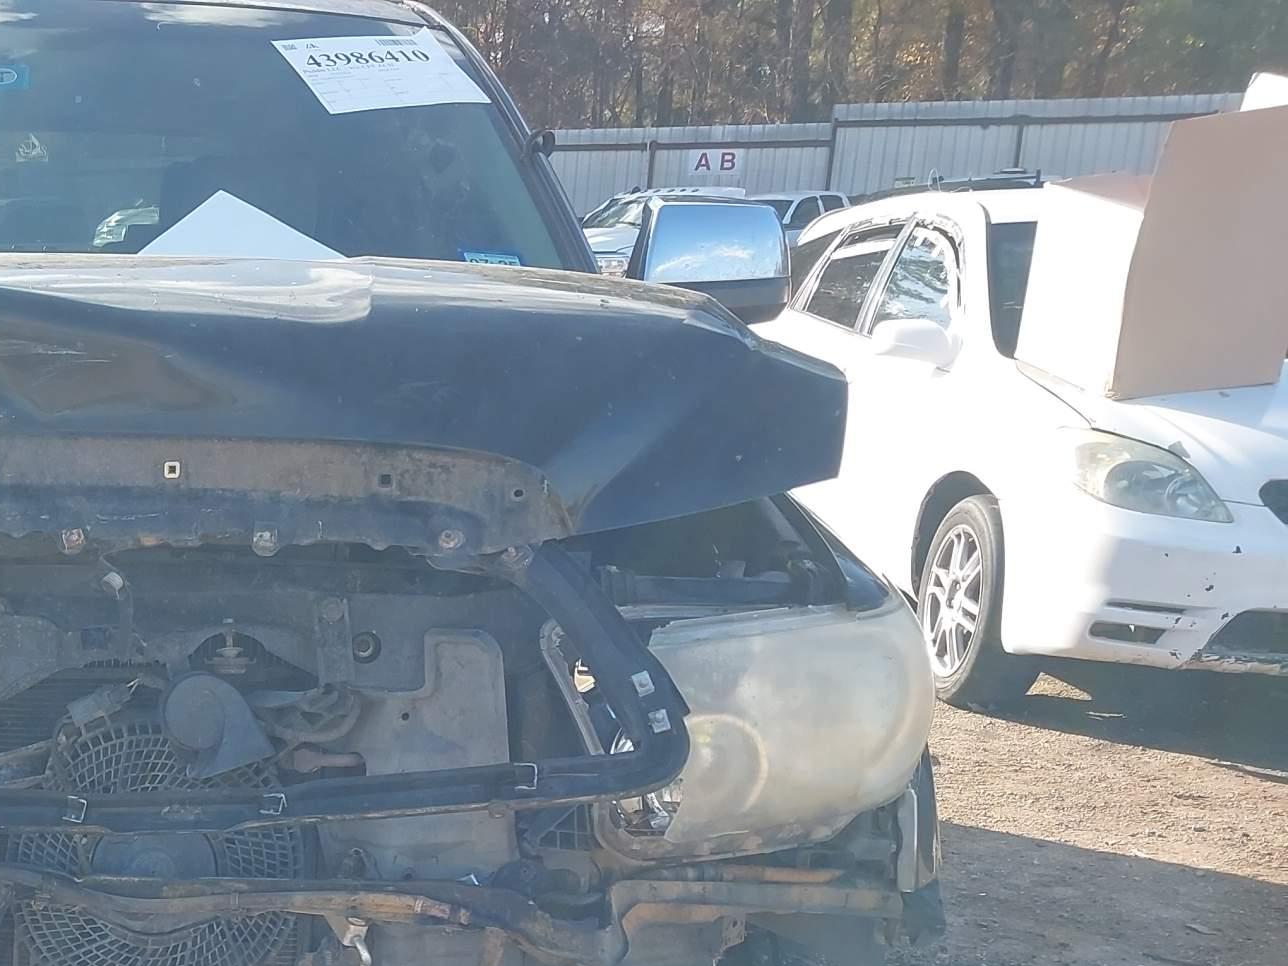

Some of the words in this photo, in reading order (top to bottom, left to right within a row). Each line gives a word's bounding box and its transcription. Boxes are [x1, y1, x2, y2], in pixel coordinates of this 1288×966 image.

[306, 49, 431, 68] 43986410
[694, 152, 711, 171] A
[720, 152, 736, 171] B
